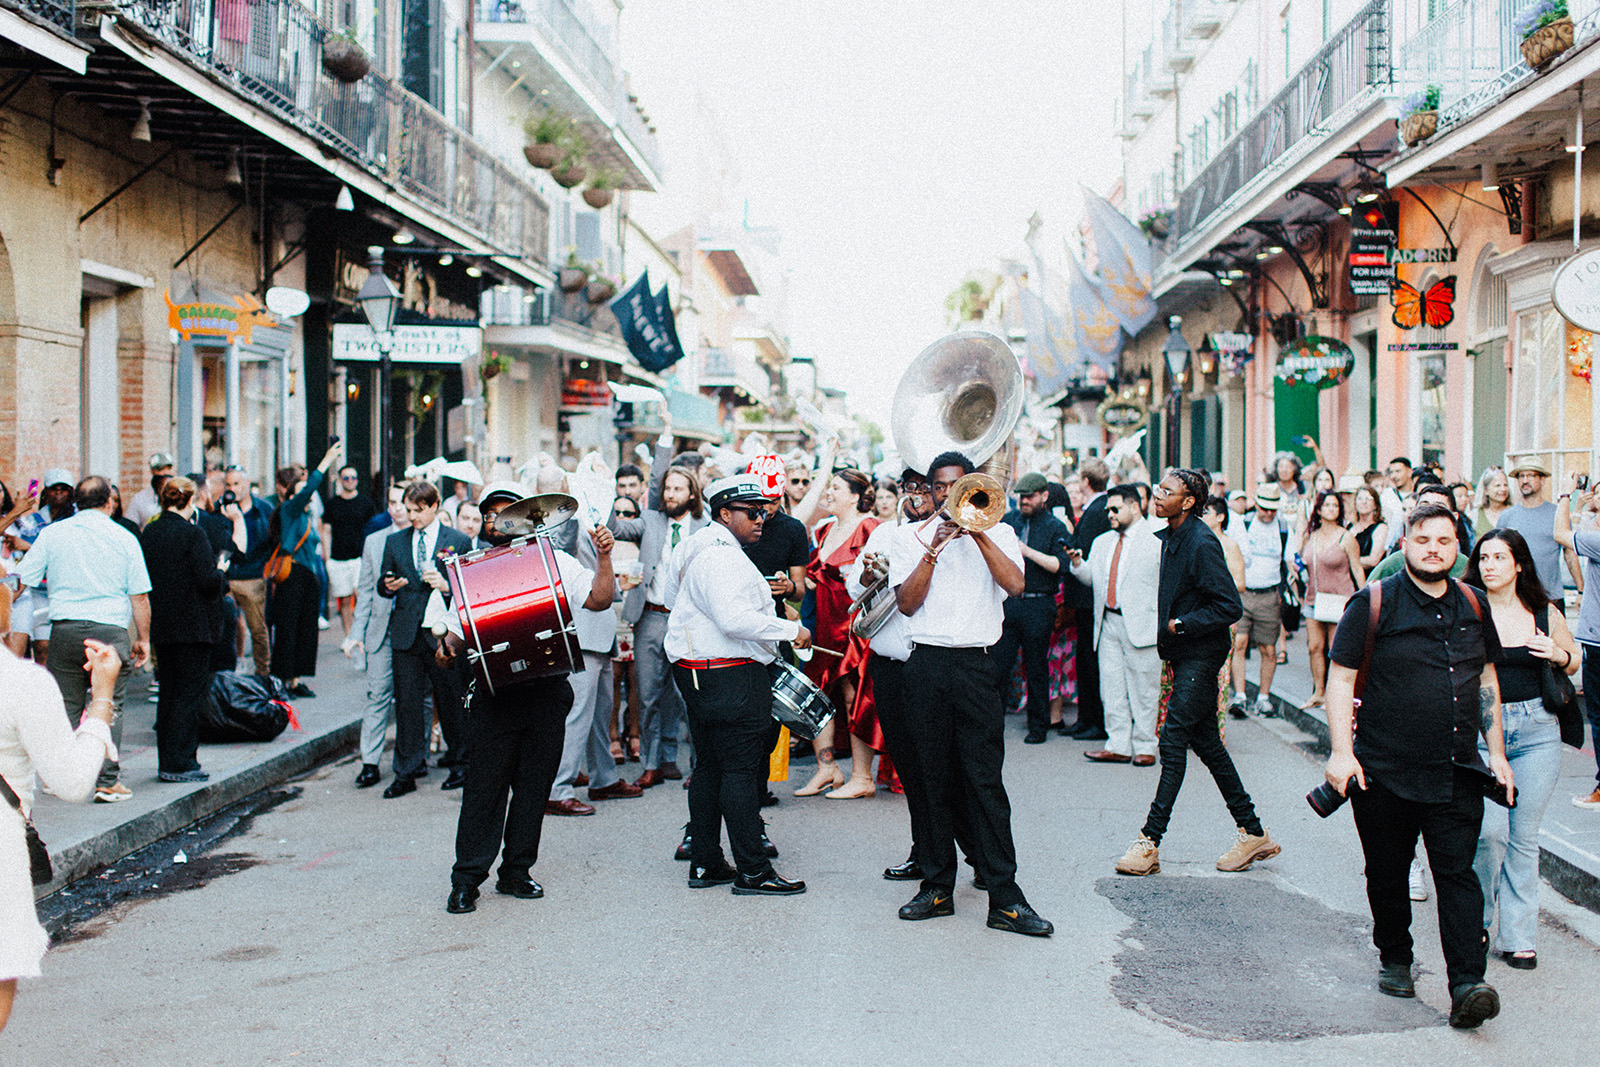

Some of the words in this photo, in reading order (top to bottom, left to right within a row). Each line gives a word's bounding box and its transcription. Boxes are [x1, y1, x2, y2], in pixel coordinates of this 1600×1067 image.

[1391, 248, 1451, 264] ADORN
[1353, 267, 1370, 277] FOR
[341, 340, 383, 352] TWO
[391, 342, 471, 356] SISTERS
